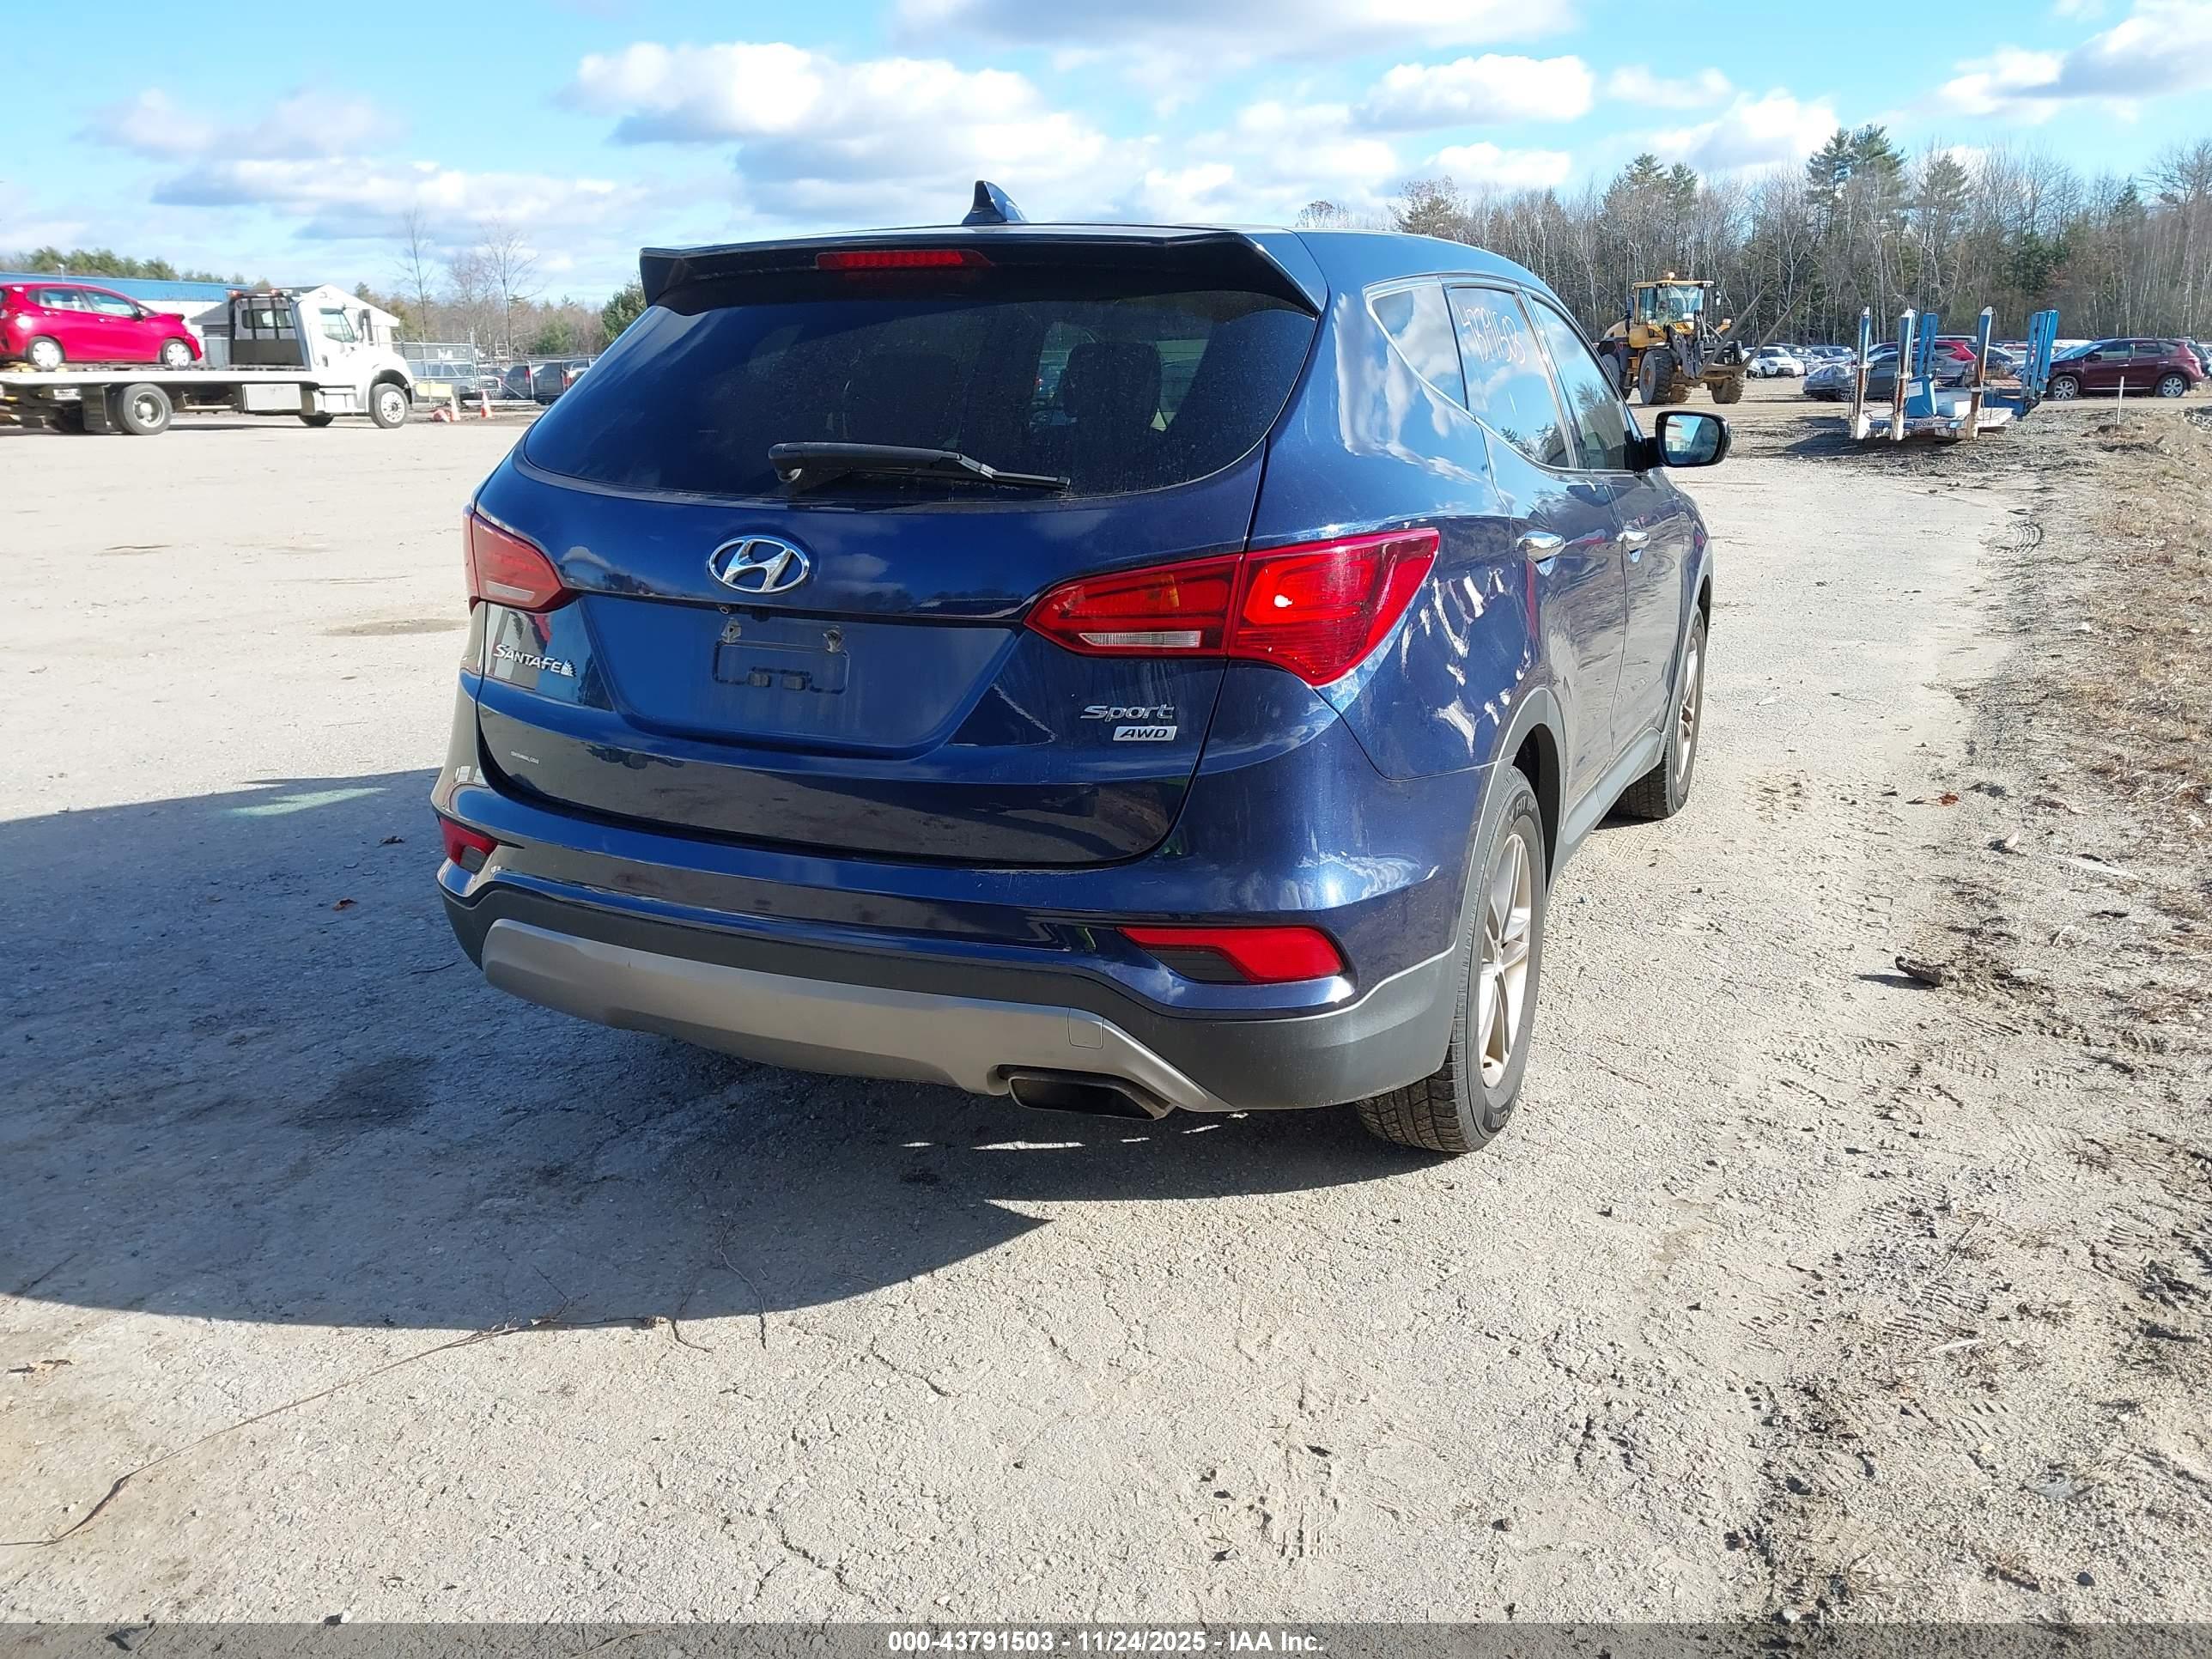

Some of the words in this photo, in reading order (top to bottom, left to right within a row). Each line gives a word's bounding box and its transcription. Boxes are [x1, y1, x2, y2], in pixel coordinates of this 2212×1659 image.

[1455, 304, 1525, 364] 43791503
[1080, 704, 1175, 721] Sport
[1120, 728, 1168, 738] AWD
